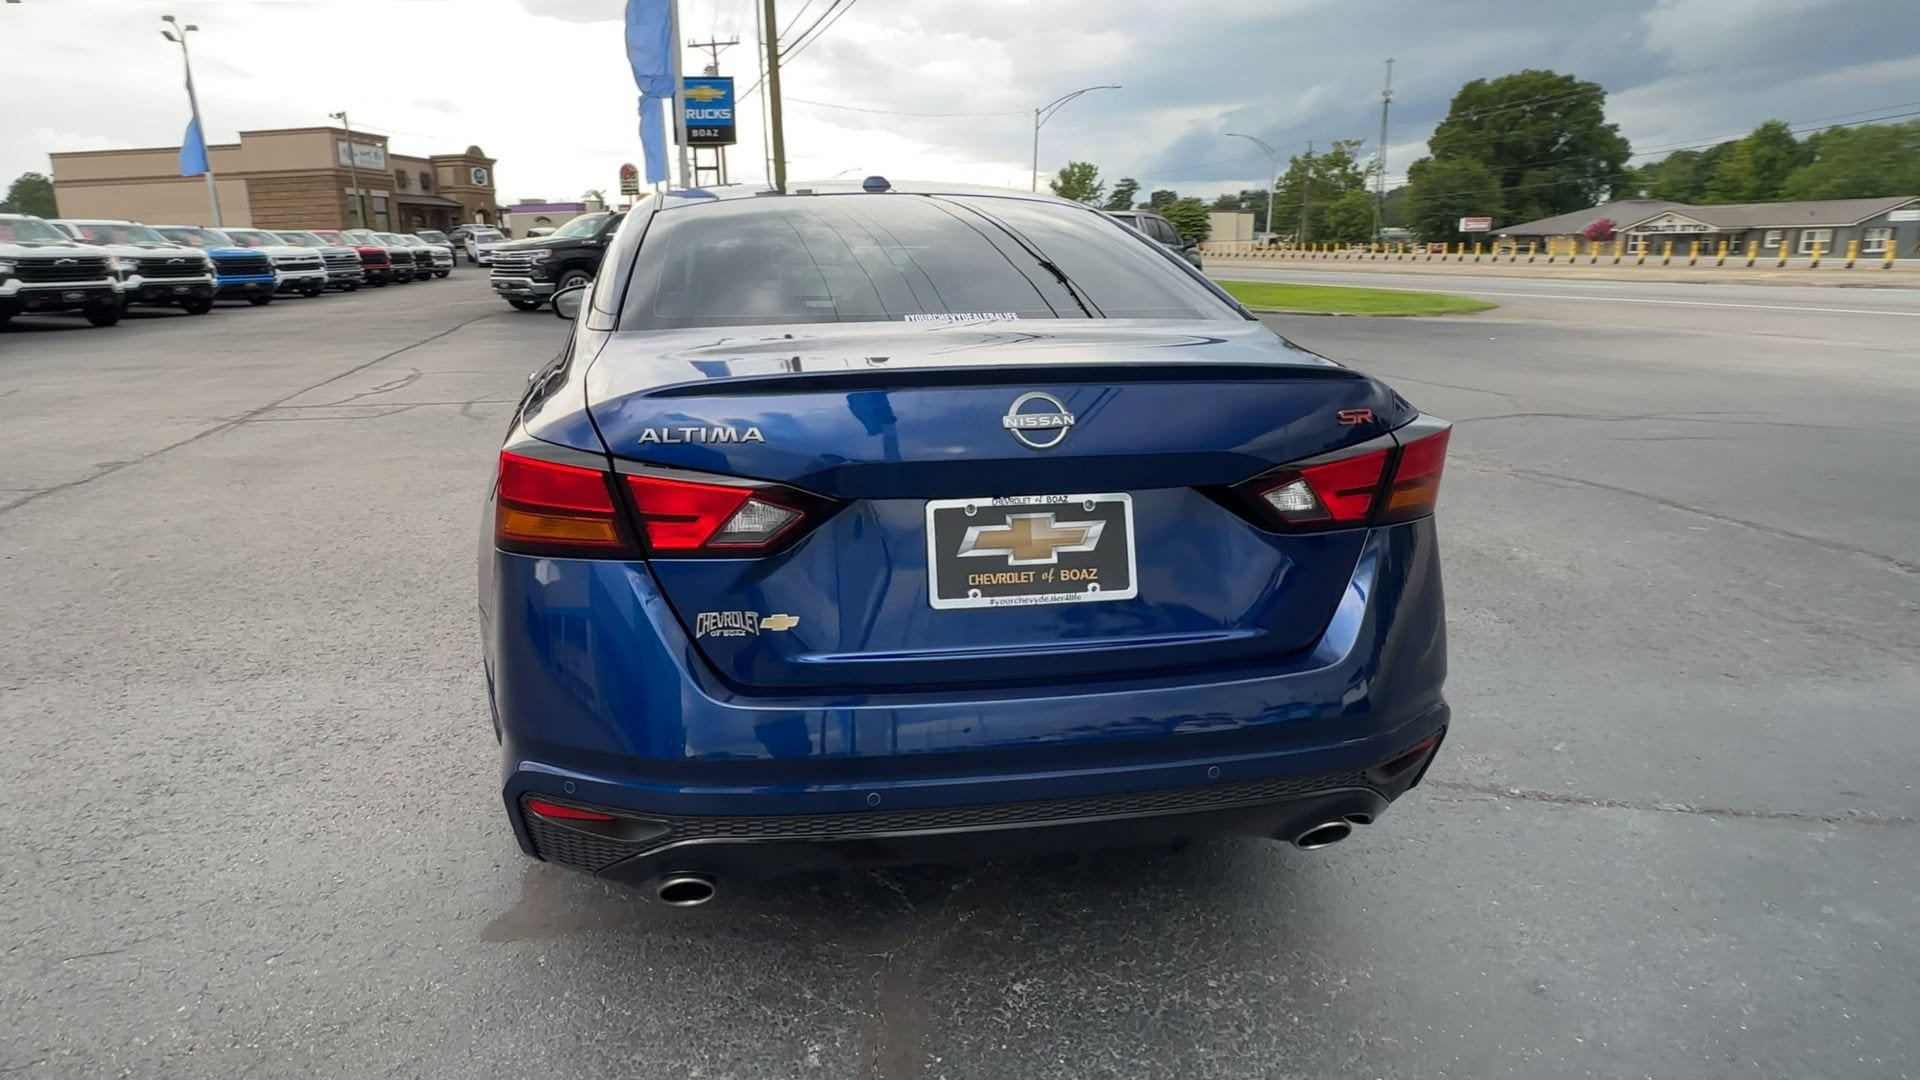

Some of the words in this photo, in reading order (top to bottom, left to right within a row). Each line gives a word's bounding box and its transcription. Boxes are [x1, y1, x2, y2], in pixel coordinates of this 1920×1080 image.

[685, 108, 731, 119] RUCKS
[691, 128, 719, 137] BOAZ
[1005, 415, 1075, 427] NISSAN
[1337, 408, 1373, 425] SR
[638, 426, 766, 444] ALTIMA
[1046, 495, 1069, 504] BOAZ
[968, 571, 1035, 586] CHEVROLET
[1041, 567, 1055, 583] of
[1060, 568, 1098, 581] BOAZ
[696, 611, 760, 639] CHEVROLET
